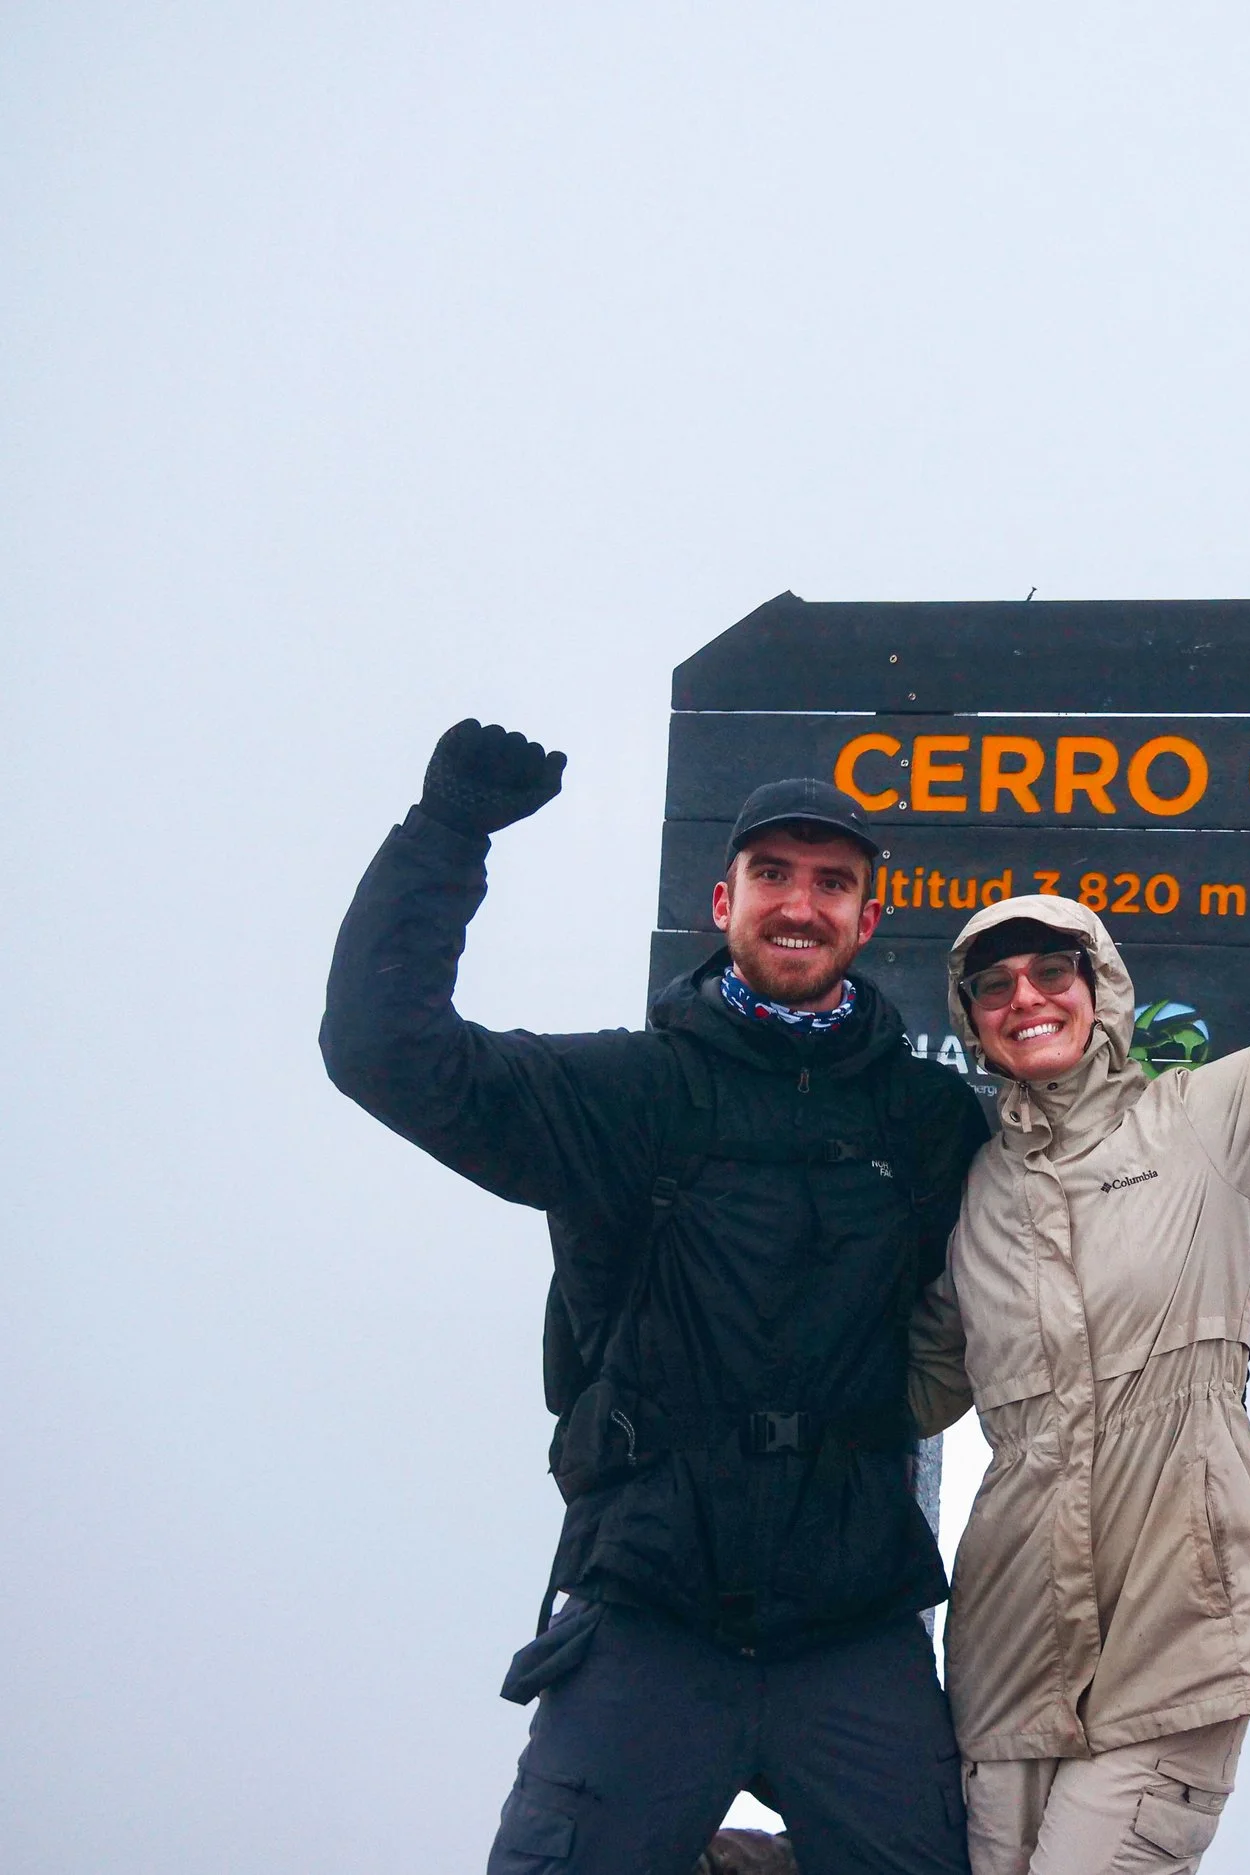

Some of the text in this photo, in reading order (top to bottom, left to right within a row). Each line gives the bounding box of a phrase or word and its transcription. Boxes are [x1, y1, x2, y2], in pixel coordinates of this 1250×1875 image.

[834, 732, 1209, 816] CERRO
[875, 865, 1013, 911] ltitud
[1201, 884, 1247, 916] m
[1112, 1169, 1159, 1190] Columbia
